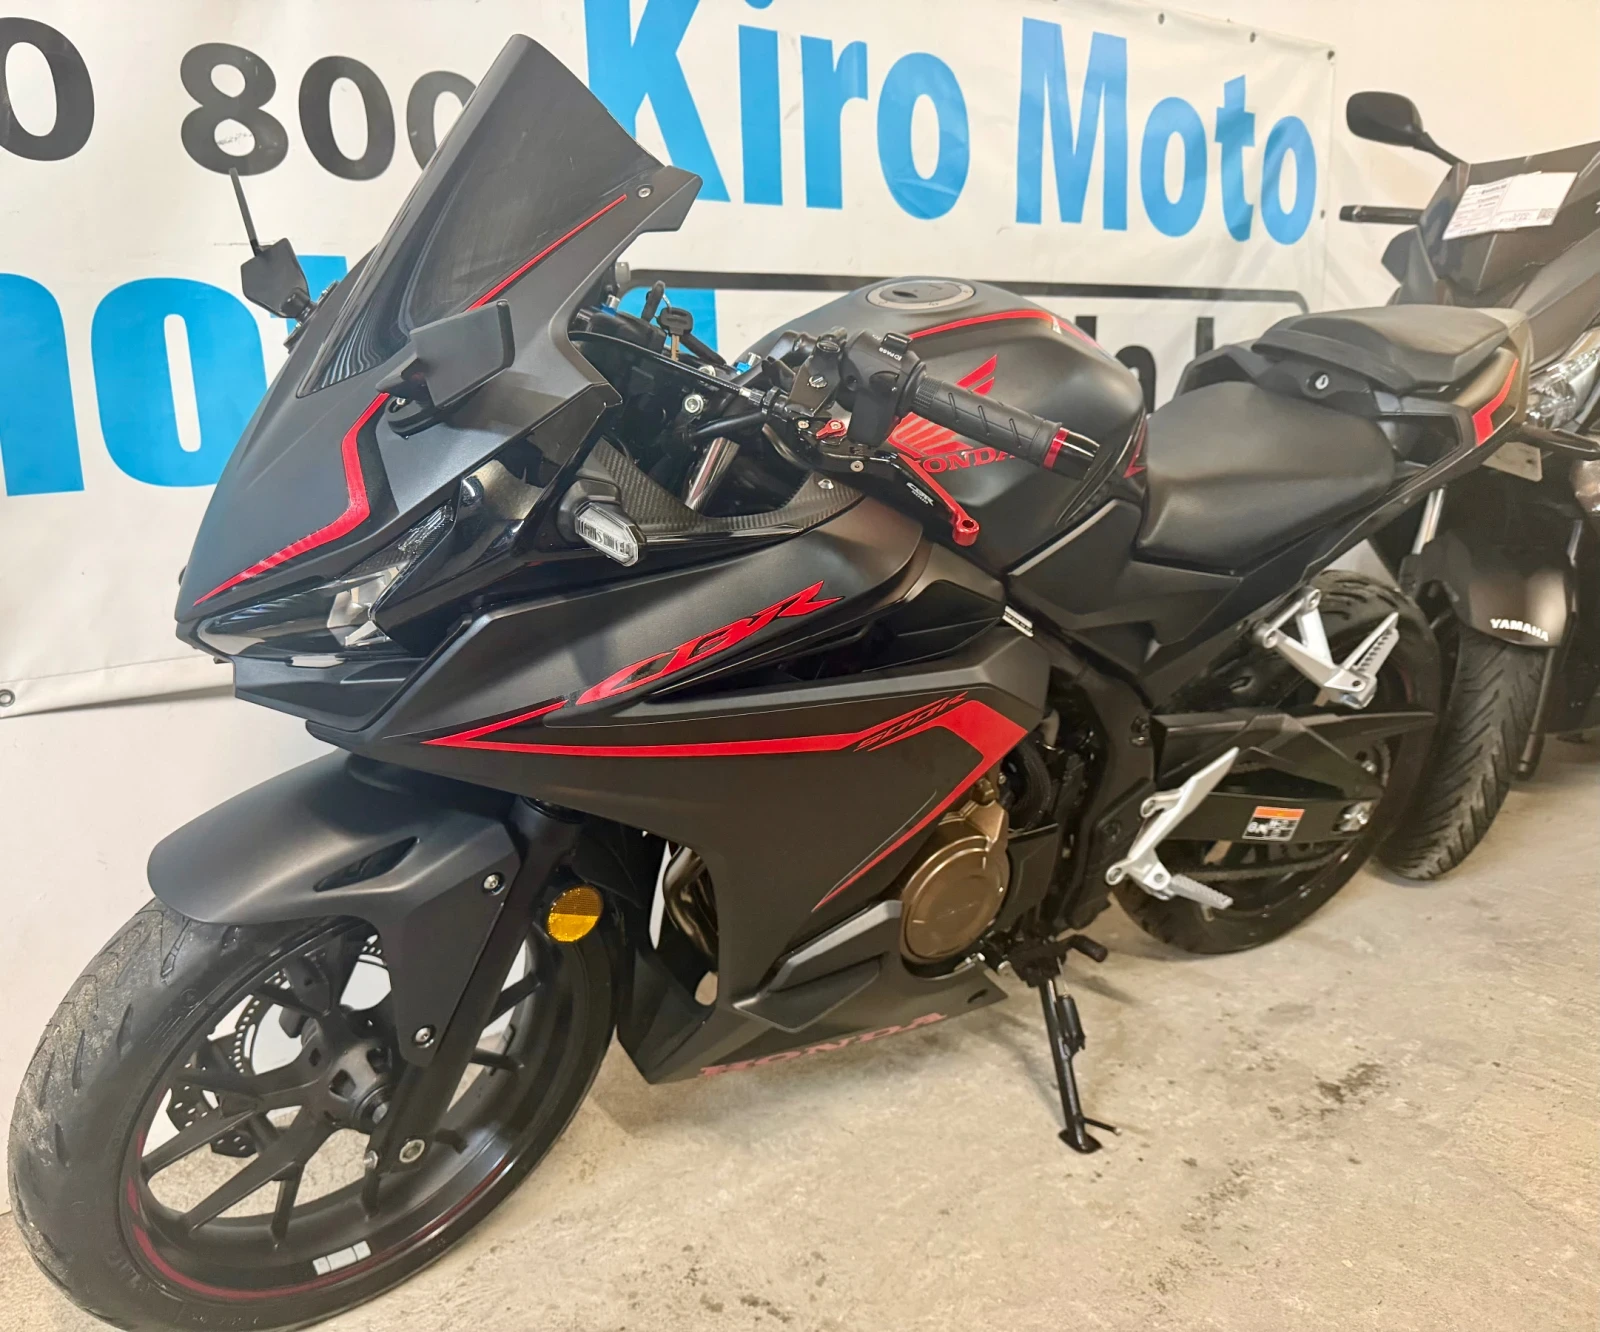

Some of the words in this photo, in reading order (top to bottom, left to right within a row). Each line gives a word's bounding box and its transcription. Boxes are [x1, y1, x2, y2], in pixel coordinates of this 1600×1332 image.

[585, 0, 970, 219] Kiro
[1015, 16, 1317, 245] Moto
[917, 446, 1016, 473] OND
[1490, 618, 1549, 642] YAMAHA
